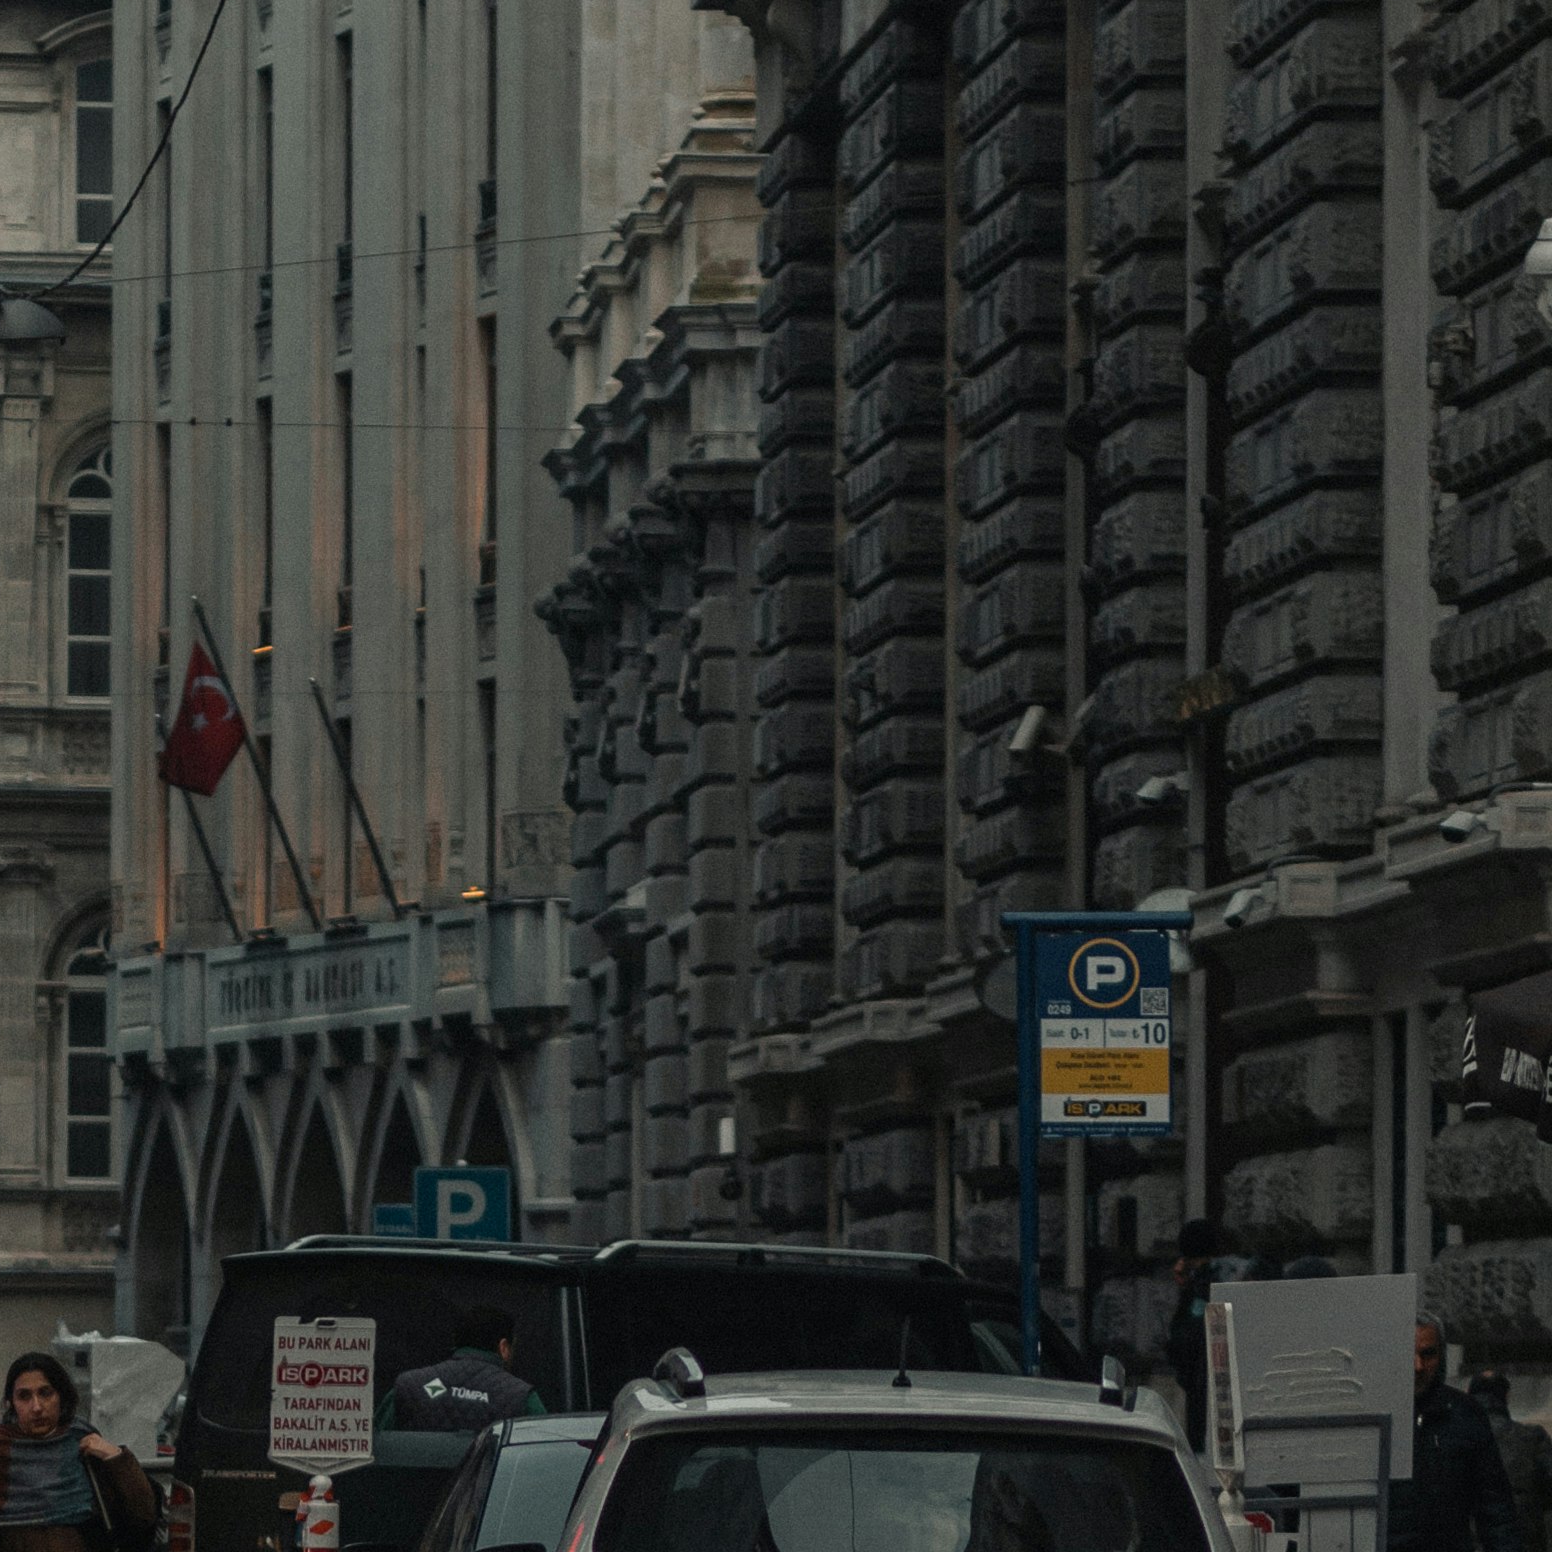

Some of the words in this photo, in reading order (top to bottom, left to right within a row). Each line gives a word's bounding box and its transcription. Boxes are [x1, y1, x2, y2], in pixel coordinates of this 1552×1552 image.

[1086, 955, 1127, 990] P
[1070, 1027, 1090, 1040] 0-1
[436, 1179, 487, 1239] P
[278, 1336, 295, 1349] BU
[299, 1337, 331, 1350] PARK
[334, 1337, 371, 1351] ALANI
[283, 1397, 361, 1411] TARAFINDAN
[273, 1416, 325, 1431] BAKALİT
[328, 1418, 351, 1433] A.Ş.
[354, 1419, 369, 1431] YE
[273, 1434, 369, 1452] KİRALANMIŞTIR
